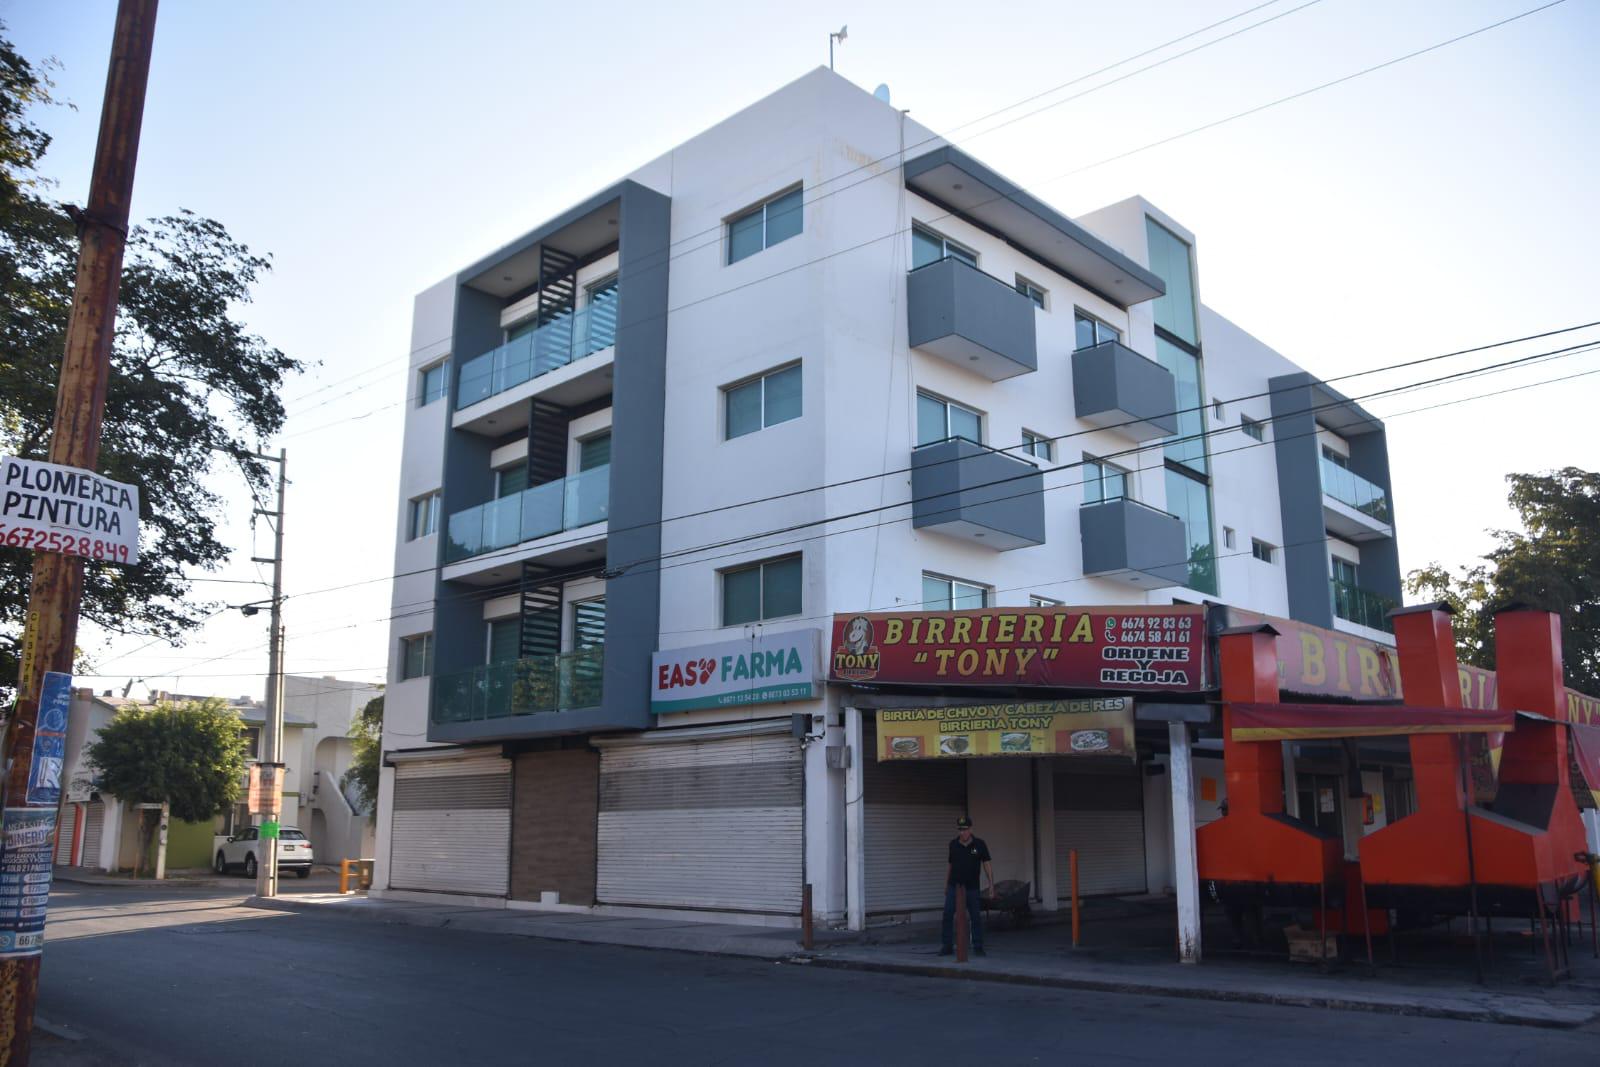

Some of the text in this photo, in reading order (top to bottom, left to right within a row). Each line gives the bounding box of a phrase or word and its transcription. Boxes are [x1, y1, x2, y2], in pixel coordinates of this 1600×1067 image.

[6, 462, 132, 511] PLOMERIA
[3, 491, 121, 535] PINTURA
[883, 613, 1094, 645] BIRRIERIA
[1121, 617, 1192, 629] 6674 92 83 63
[1121, 631, 1191, 643] 6674 58 41 61
[835, 653, 879, 670] TONY
[1103, 647, 1189, 661] ORDENE
[721, 647, 802, 682] FARMA
[1136, 659, 1152, 671] Y
[1101, 670, 1188, 684] RECOJA
[883, 698, 1124, 721] BIRRIA DE CHIVO Y CABEZA DE RES
[940, 717, 1052, 733] BIRRIERIA TONY
